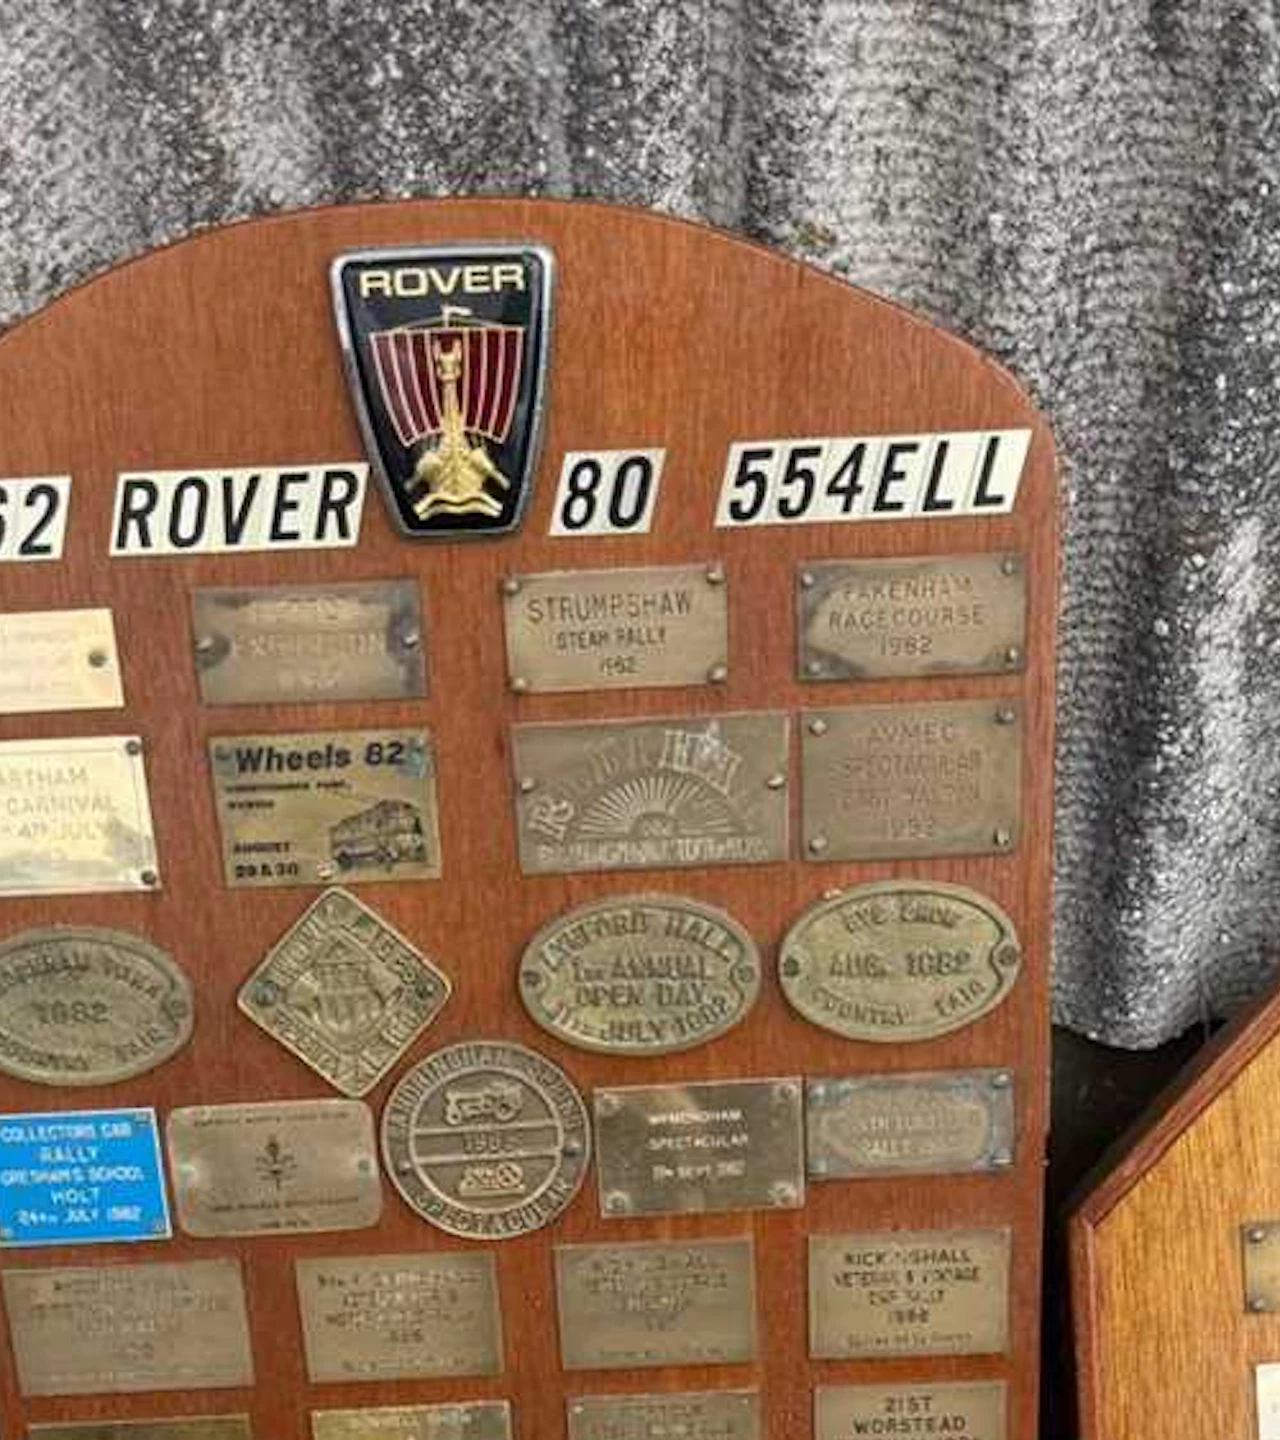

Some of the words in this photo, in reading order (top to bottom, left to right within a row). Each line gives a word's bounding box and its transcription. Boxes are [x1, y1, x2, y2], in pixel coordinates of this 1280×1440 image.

[359, 264, 524, 297] ROVER
[563, 456, 654, 529] 80
[730, 437, 1007, 521] 554ELL
[116, 470, 358, 551] ROVER
[830, 606, 985, 630] RACECOURSE
[236, 744, 353, 773] Wheels
[365, 742, 406, 767] 82
[40, 1146, 100, 1163] RALLY
[50, 1188, 100, 1206] HOLT
[883, 1397, 933, 1412] 21ST
[853, 1415, 966, 1435] WORSTEAD
